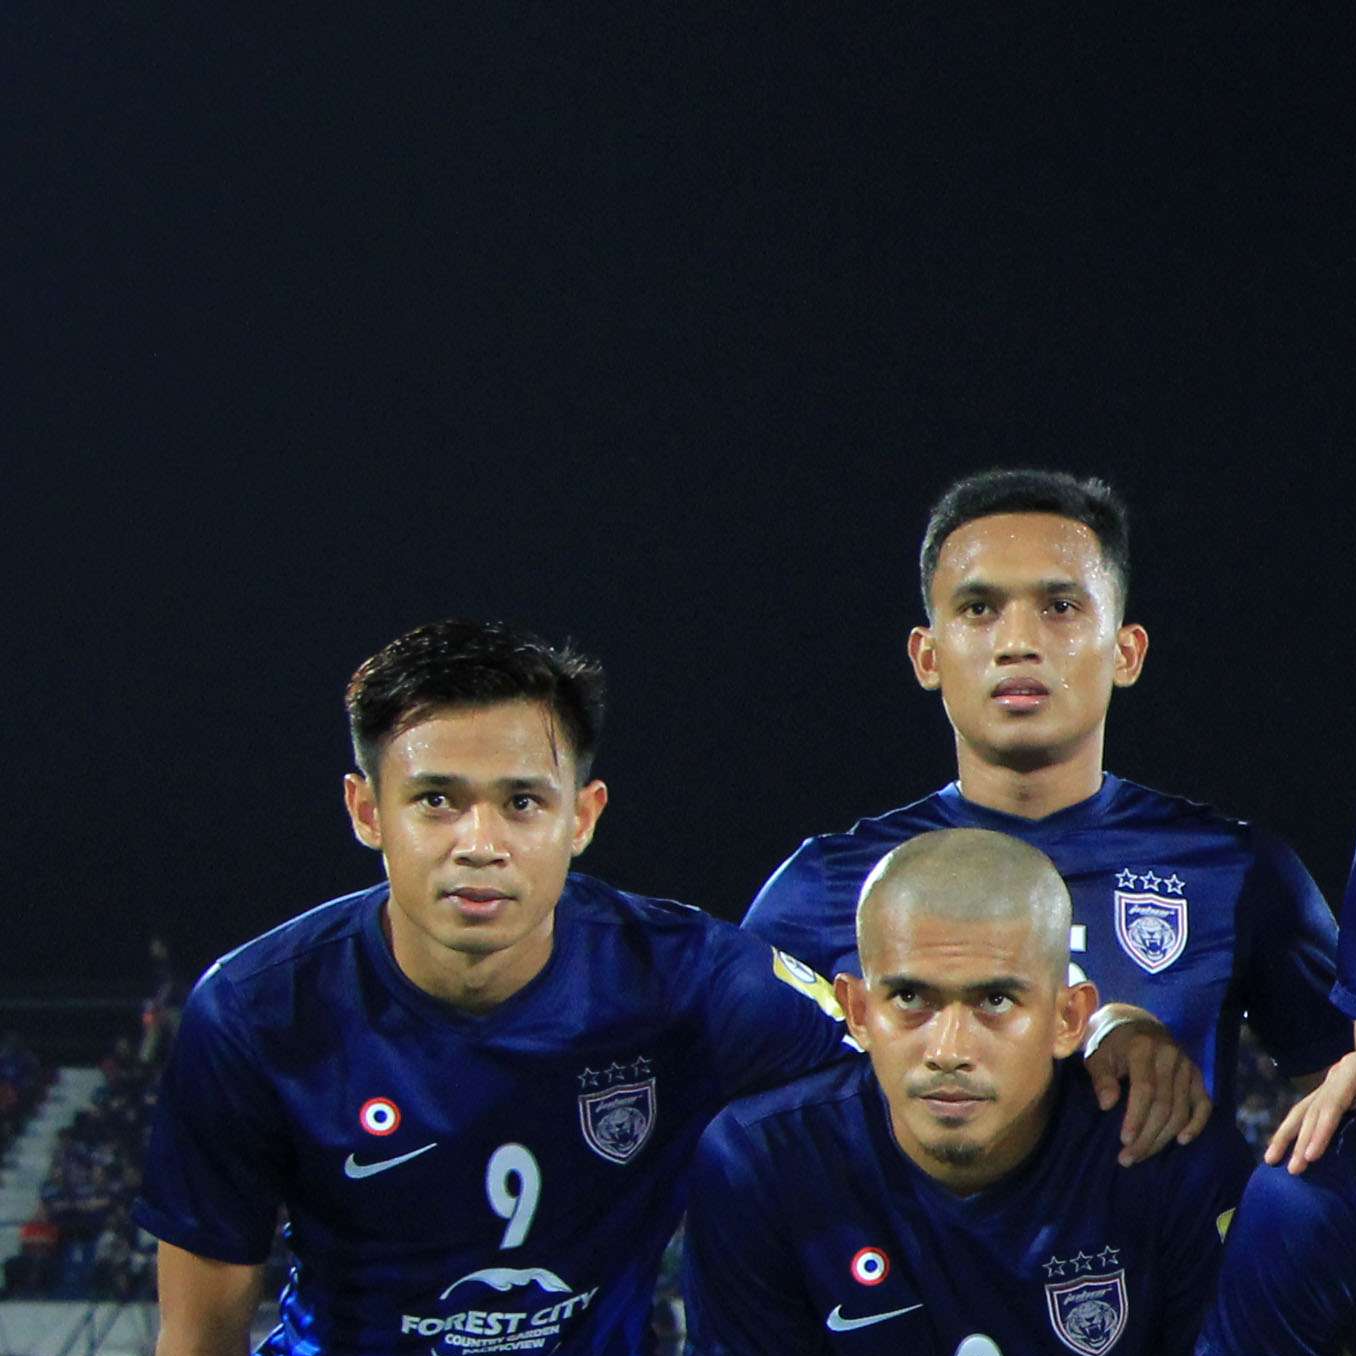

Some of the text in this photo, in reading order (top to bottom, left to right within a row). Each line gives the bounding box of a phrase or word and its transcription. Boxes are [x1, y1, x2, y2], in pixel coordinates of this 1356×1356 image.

[485, 1141, 542, 1250] 9
[401, 1286, 600, 1337] FOREST CITY
